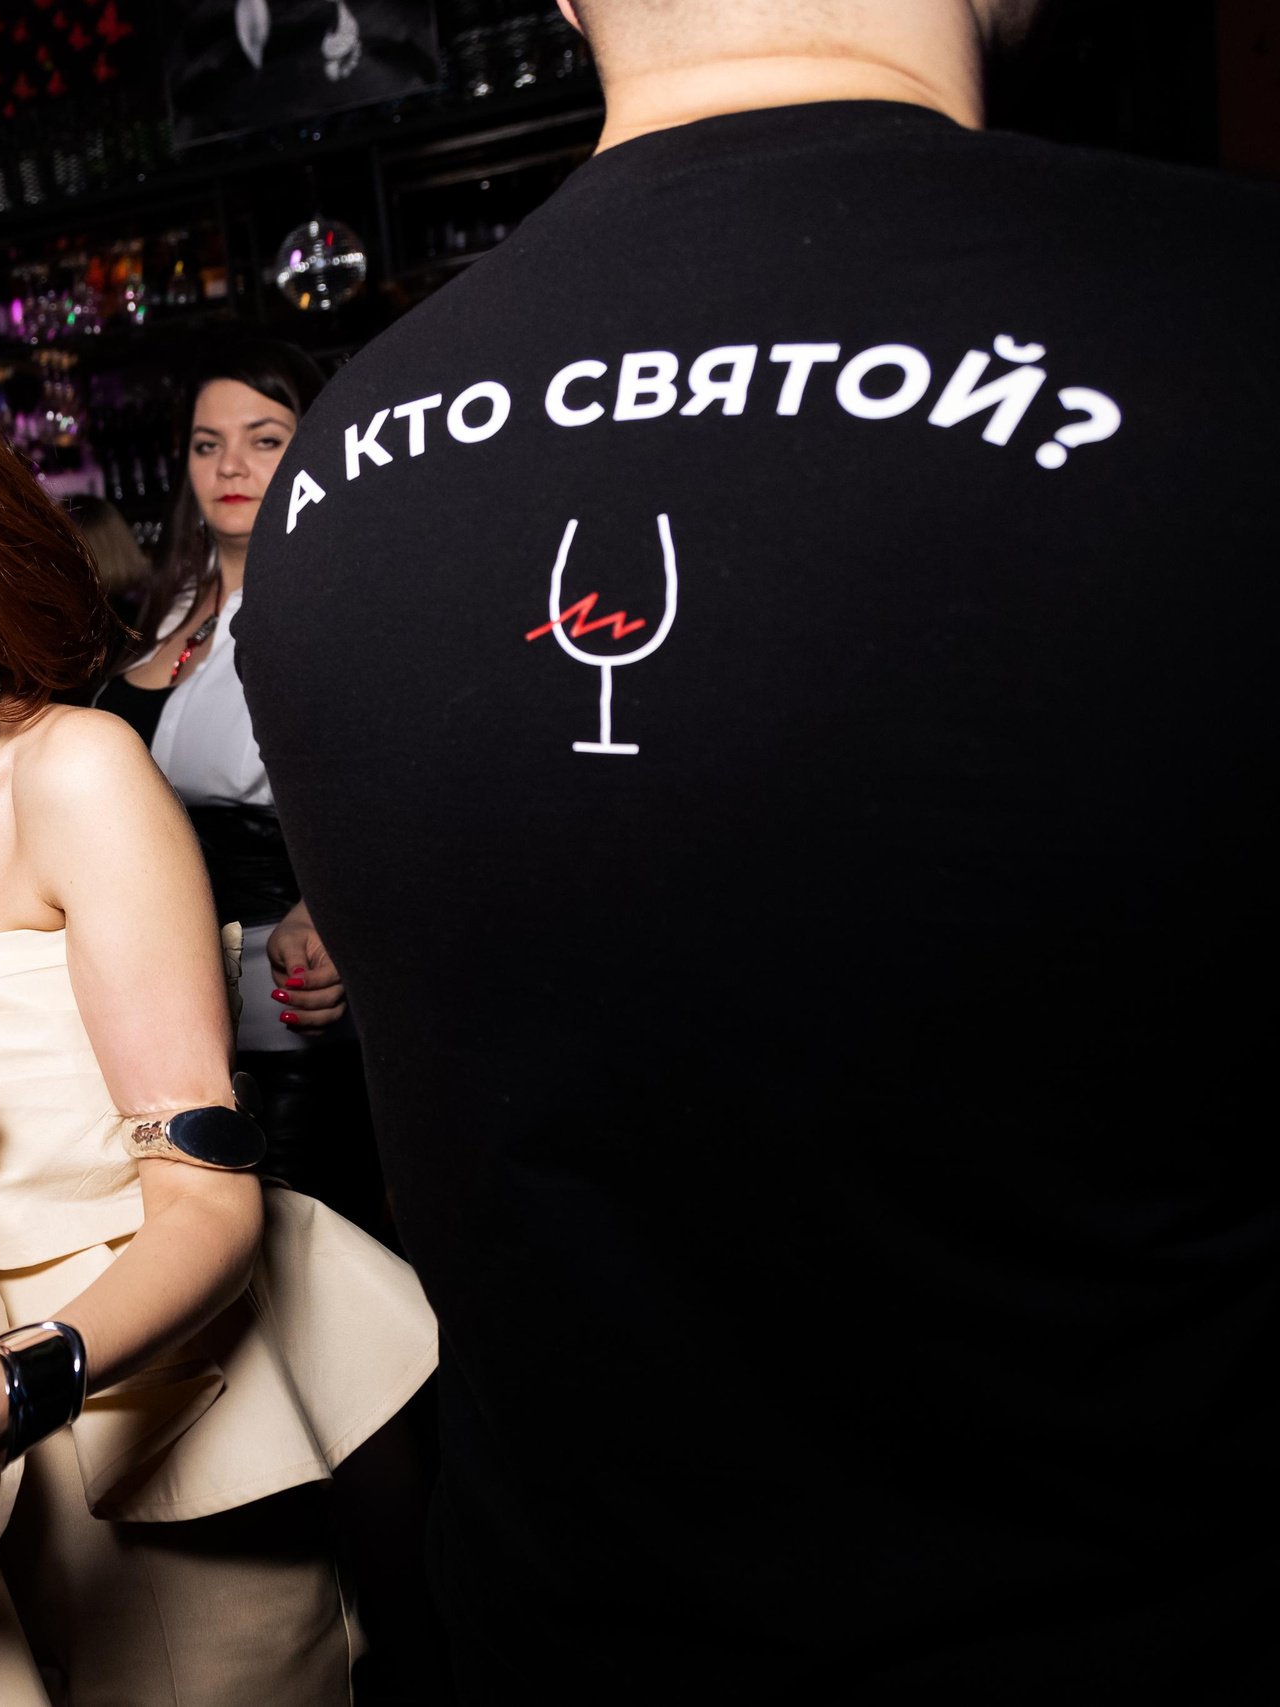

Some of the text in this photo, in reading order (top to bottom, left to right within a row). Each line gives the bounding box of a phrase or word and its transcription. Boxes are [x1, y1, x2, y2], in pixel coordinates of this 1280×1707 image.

[285, 334, 1122, 535] А КТО СВЯТОЙ?
